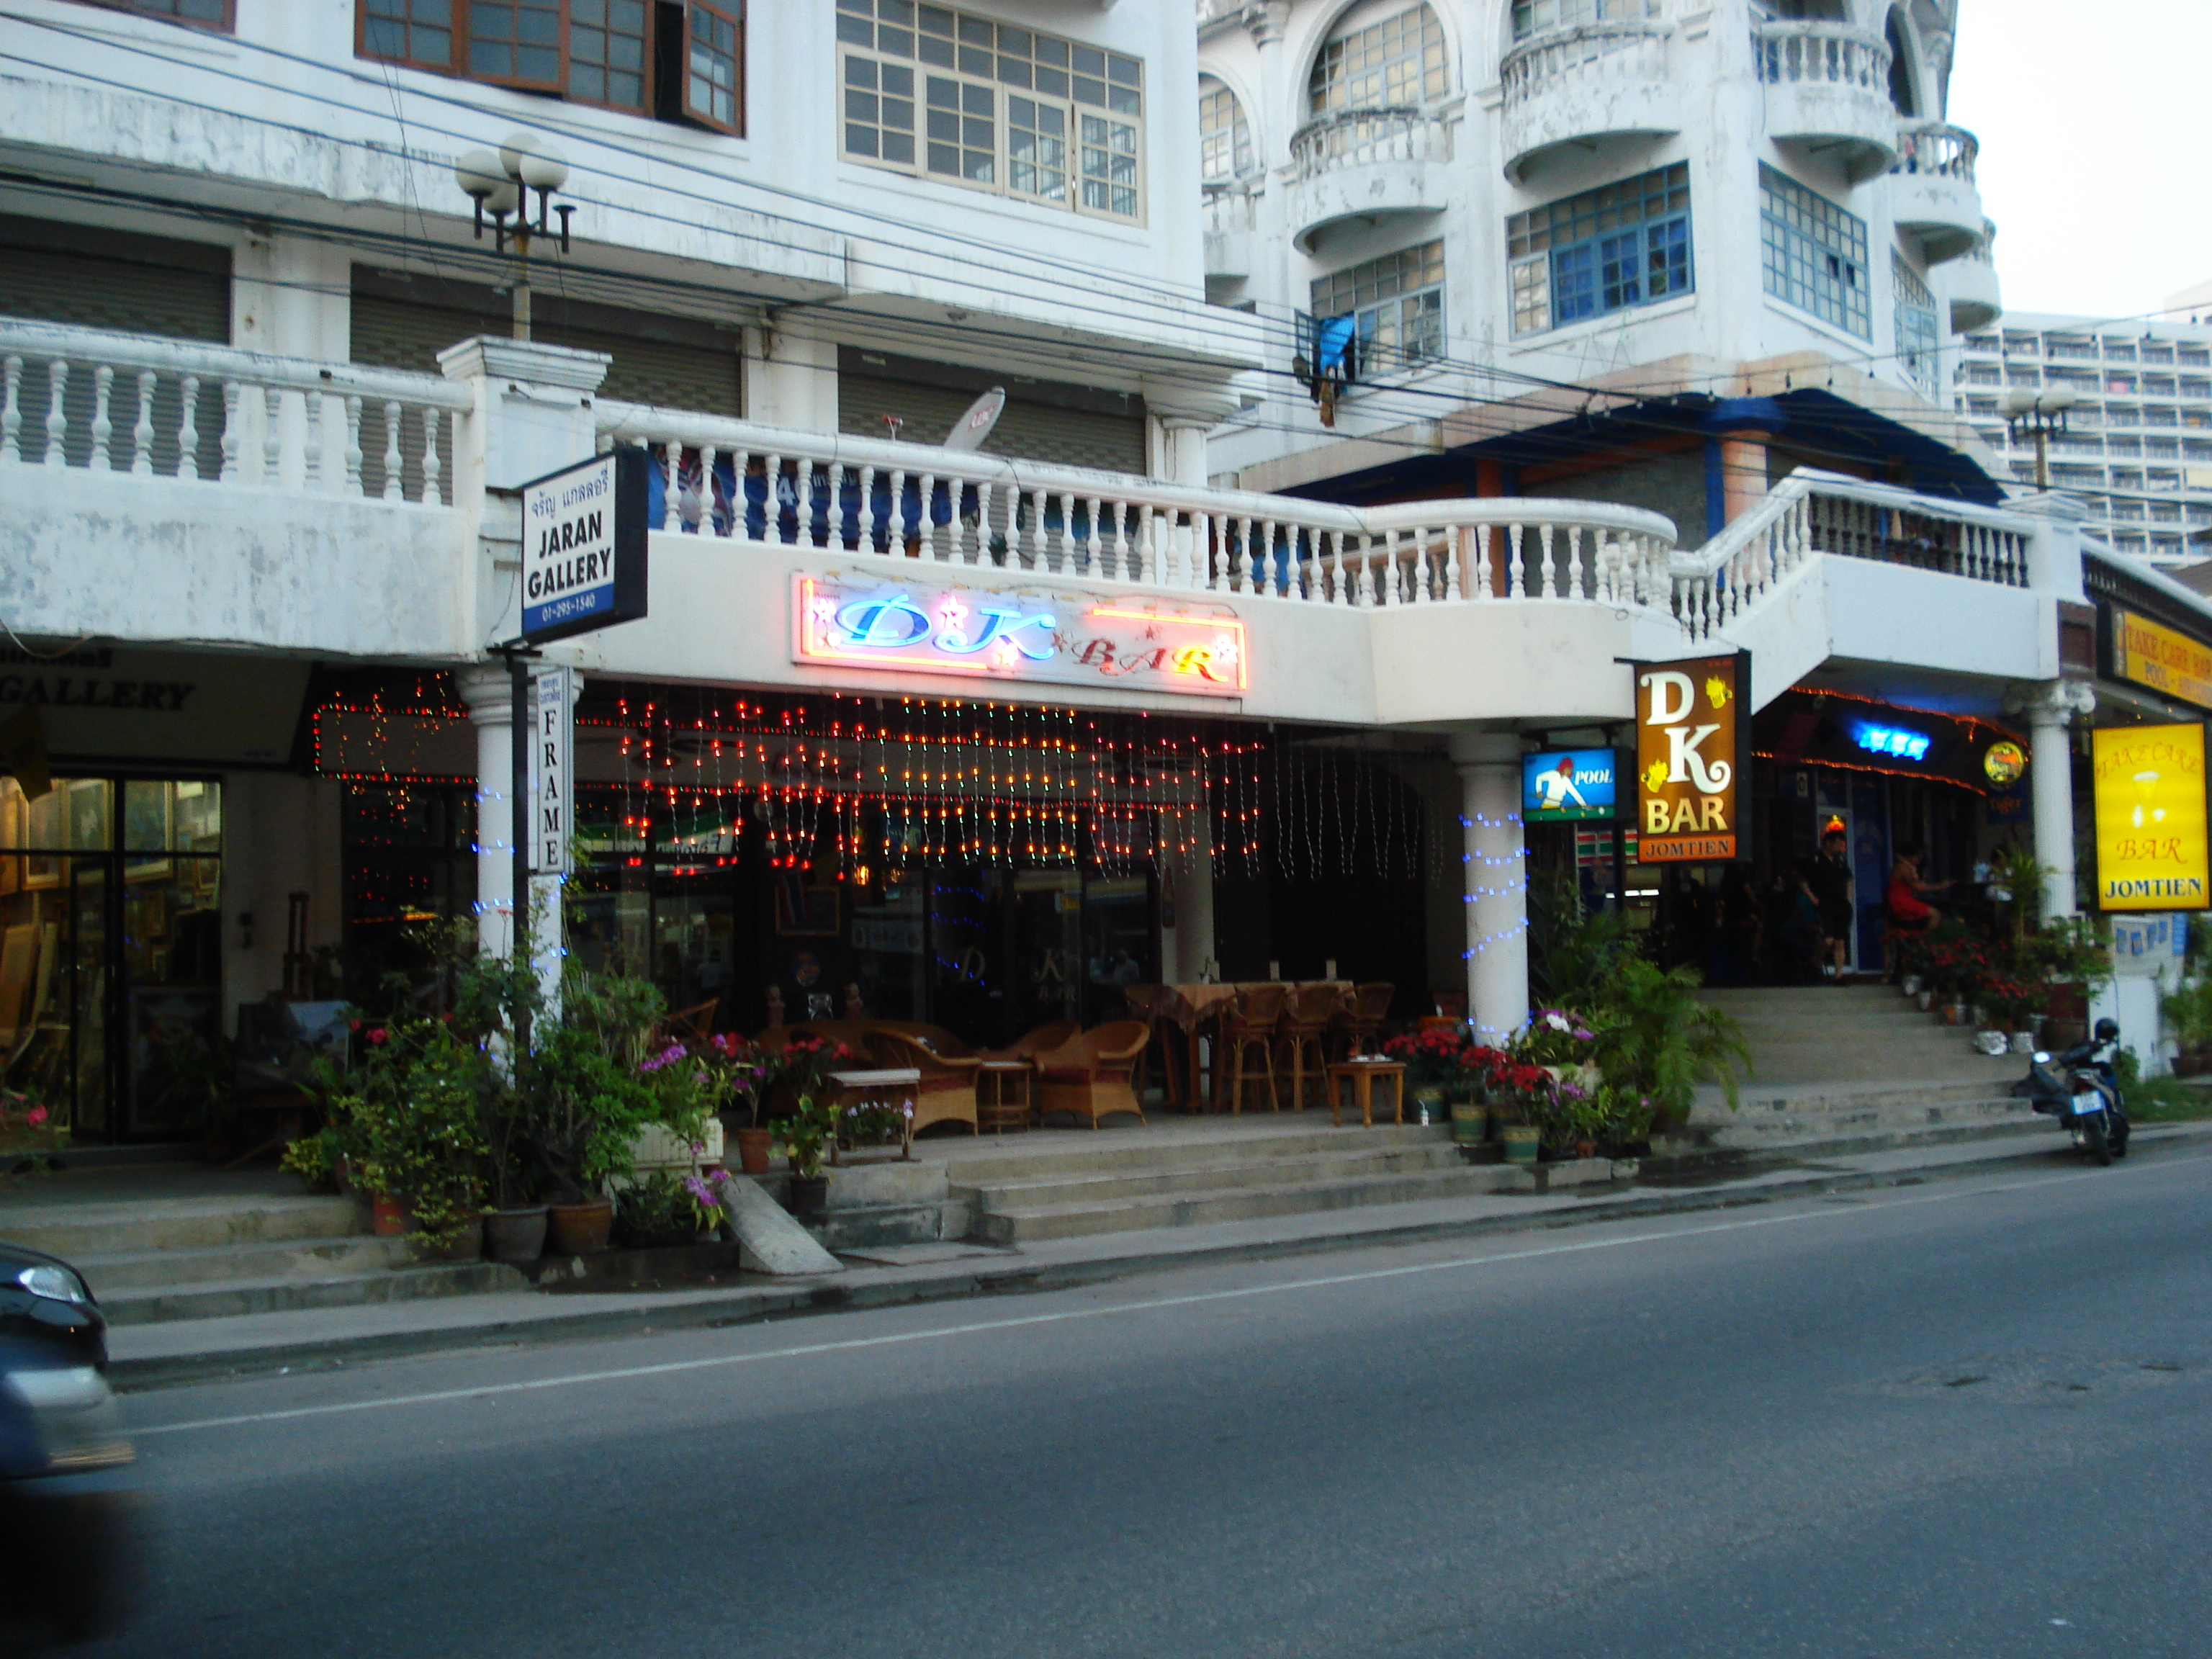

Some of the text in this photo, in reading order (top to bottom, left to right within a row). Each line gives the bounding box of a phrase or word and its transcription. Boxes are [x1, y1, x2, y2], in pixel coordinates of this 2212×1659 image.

[539, 510, 603, 559] JARAN
[529, 547, 612, 600] GALLERY
[1079, 637, 1229, 682] BAR
[0, 675, 195, 711] GALLERY
[544, 709, 561, 866] FRAME
[1575, 768, 1613, 786] POOL
[1646, 795, 1728, 835] BAR
[1646, 840, 1730, 858] JOMTIEN
[2117, 837, 2188, 864] BAR
[2105, 877, 2203, 899] JOMTIEN
